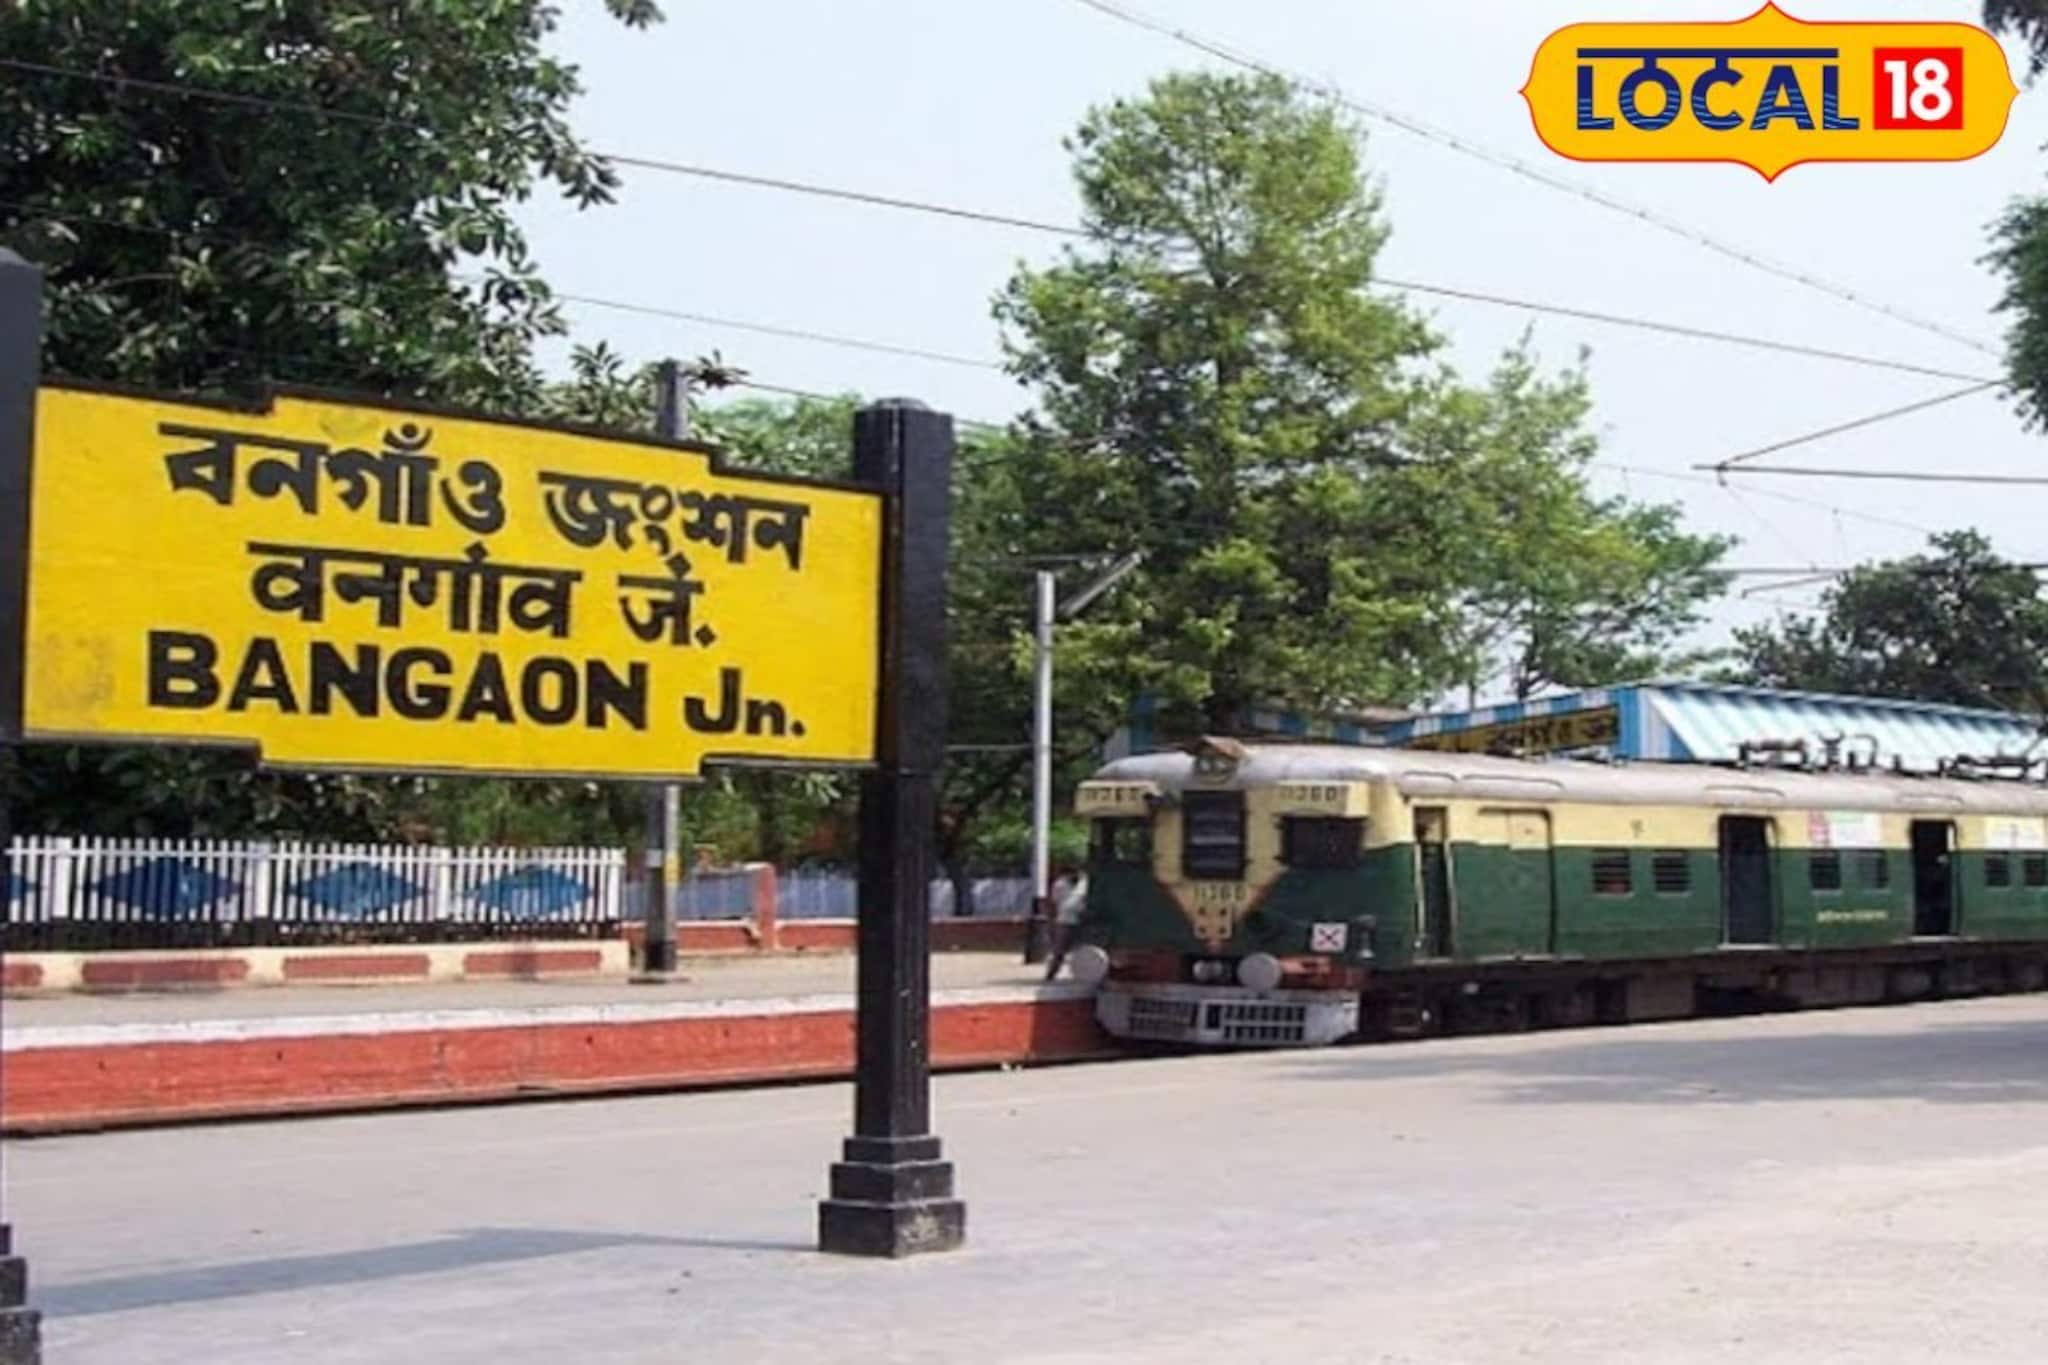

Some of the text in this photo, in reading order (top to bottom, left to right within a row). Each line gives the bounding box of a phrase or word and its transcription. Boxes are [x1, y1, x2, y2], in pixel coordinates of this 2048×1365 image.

[158, 422, 811, 571] বনগাঁও জংশন
[246, 541, 583, 638] वनगांव
[147, 630, 807, 736] BANGAON Jn.
